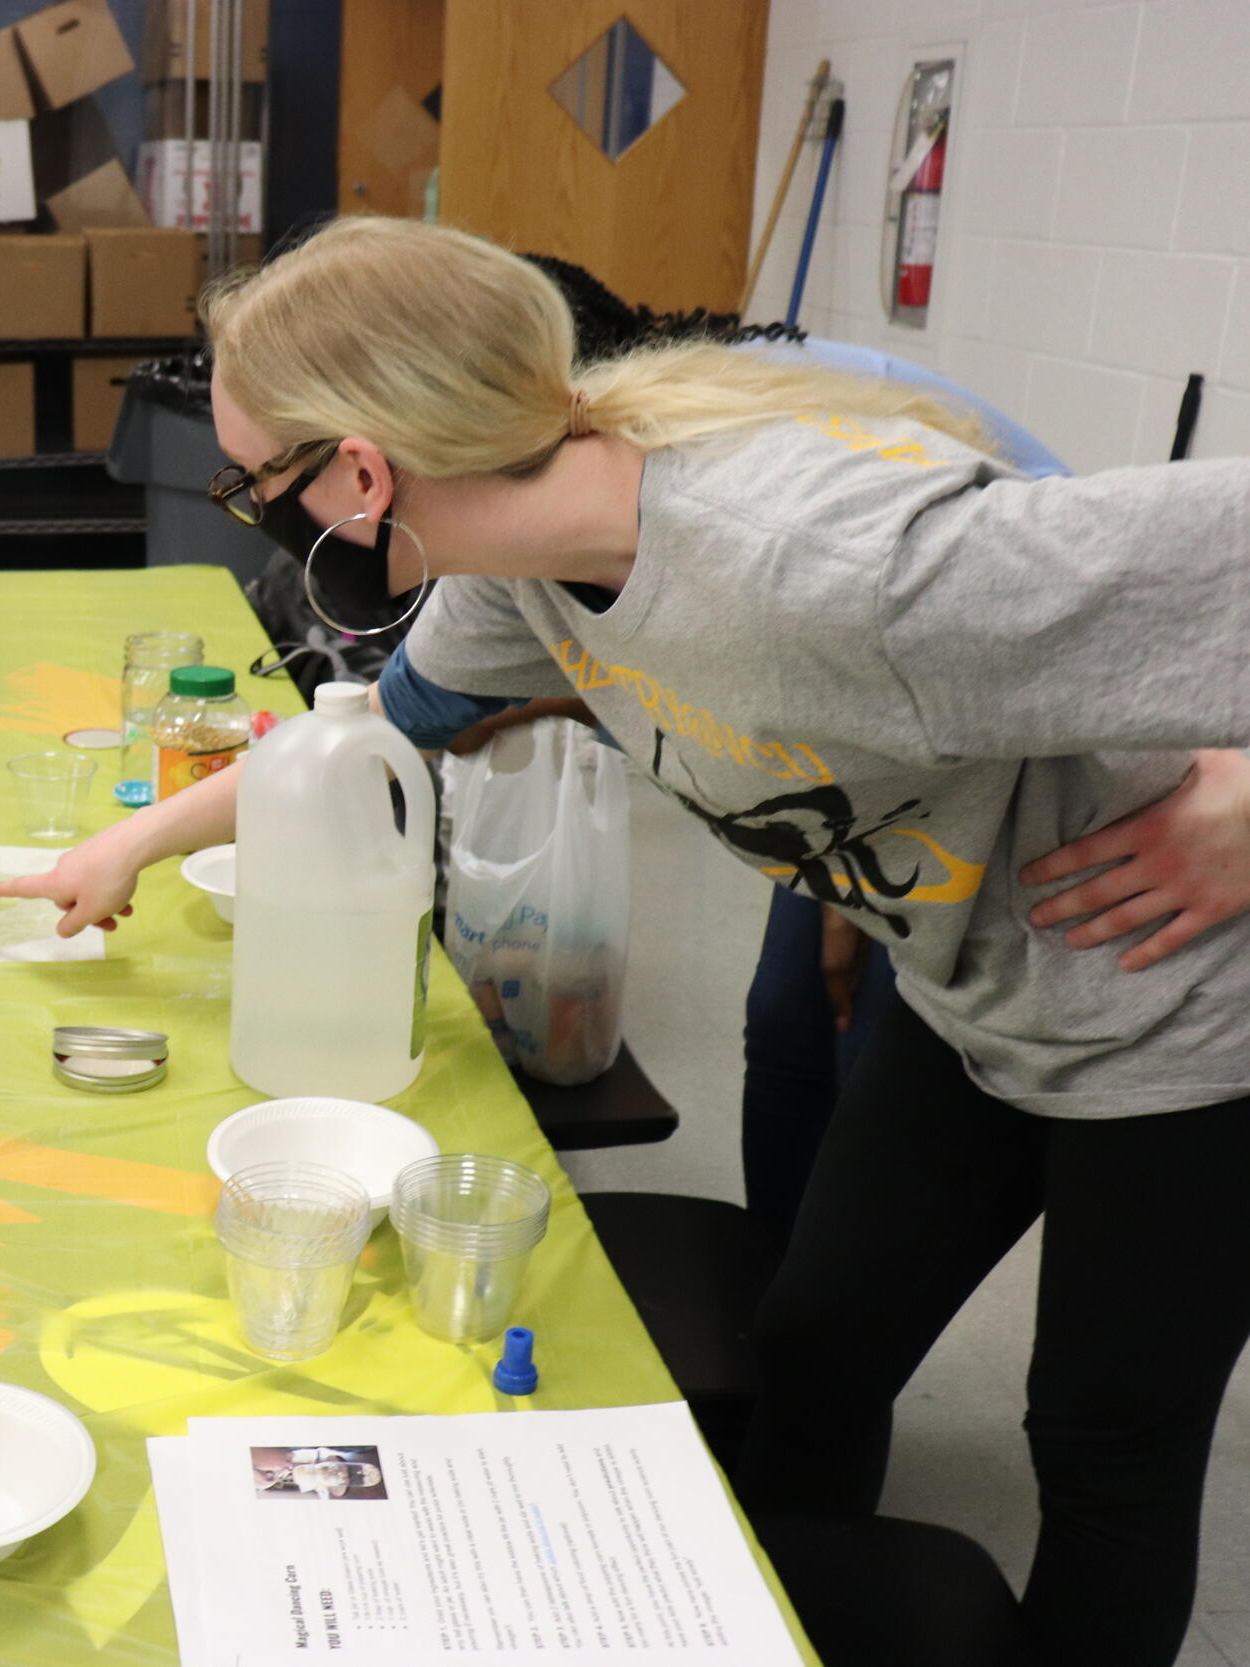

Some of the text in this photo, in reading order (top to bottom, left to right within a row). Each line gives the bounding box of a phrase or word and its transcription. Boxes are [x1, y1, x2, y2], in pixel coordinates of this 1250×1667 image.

[285, 1564, 310, 1648] Magical Dancing Corn
[323, 1613, 337, 1630] WILL
[327, 1633, 342, 1649] YOU
